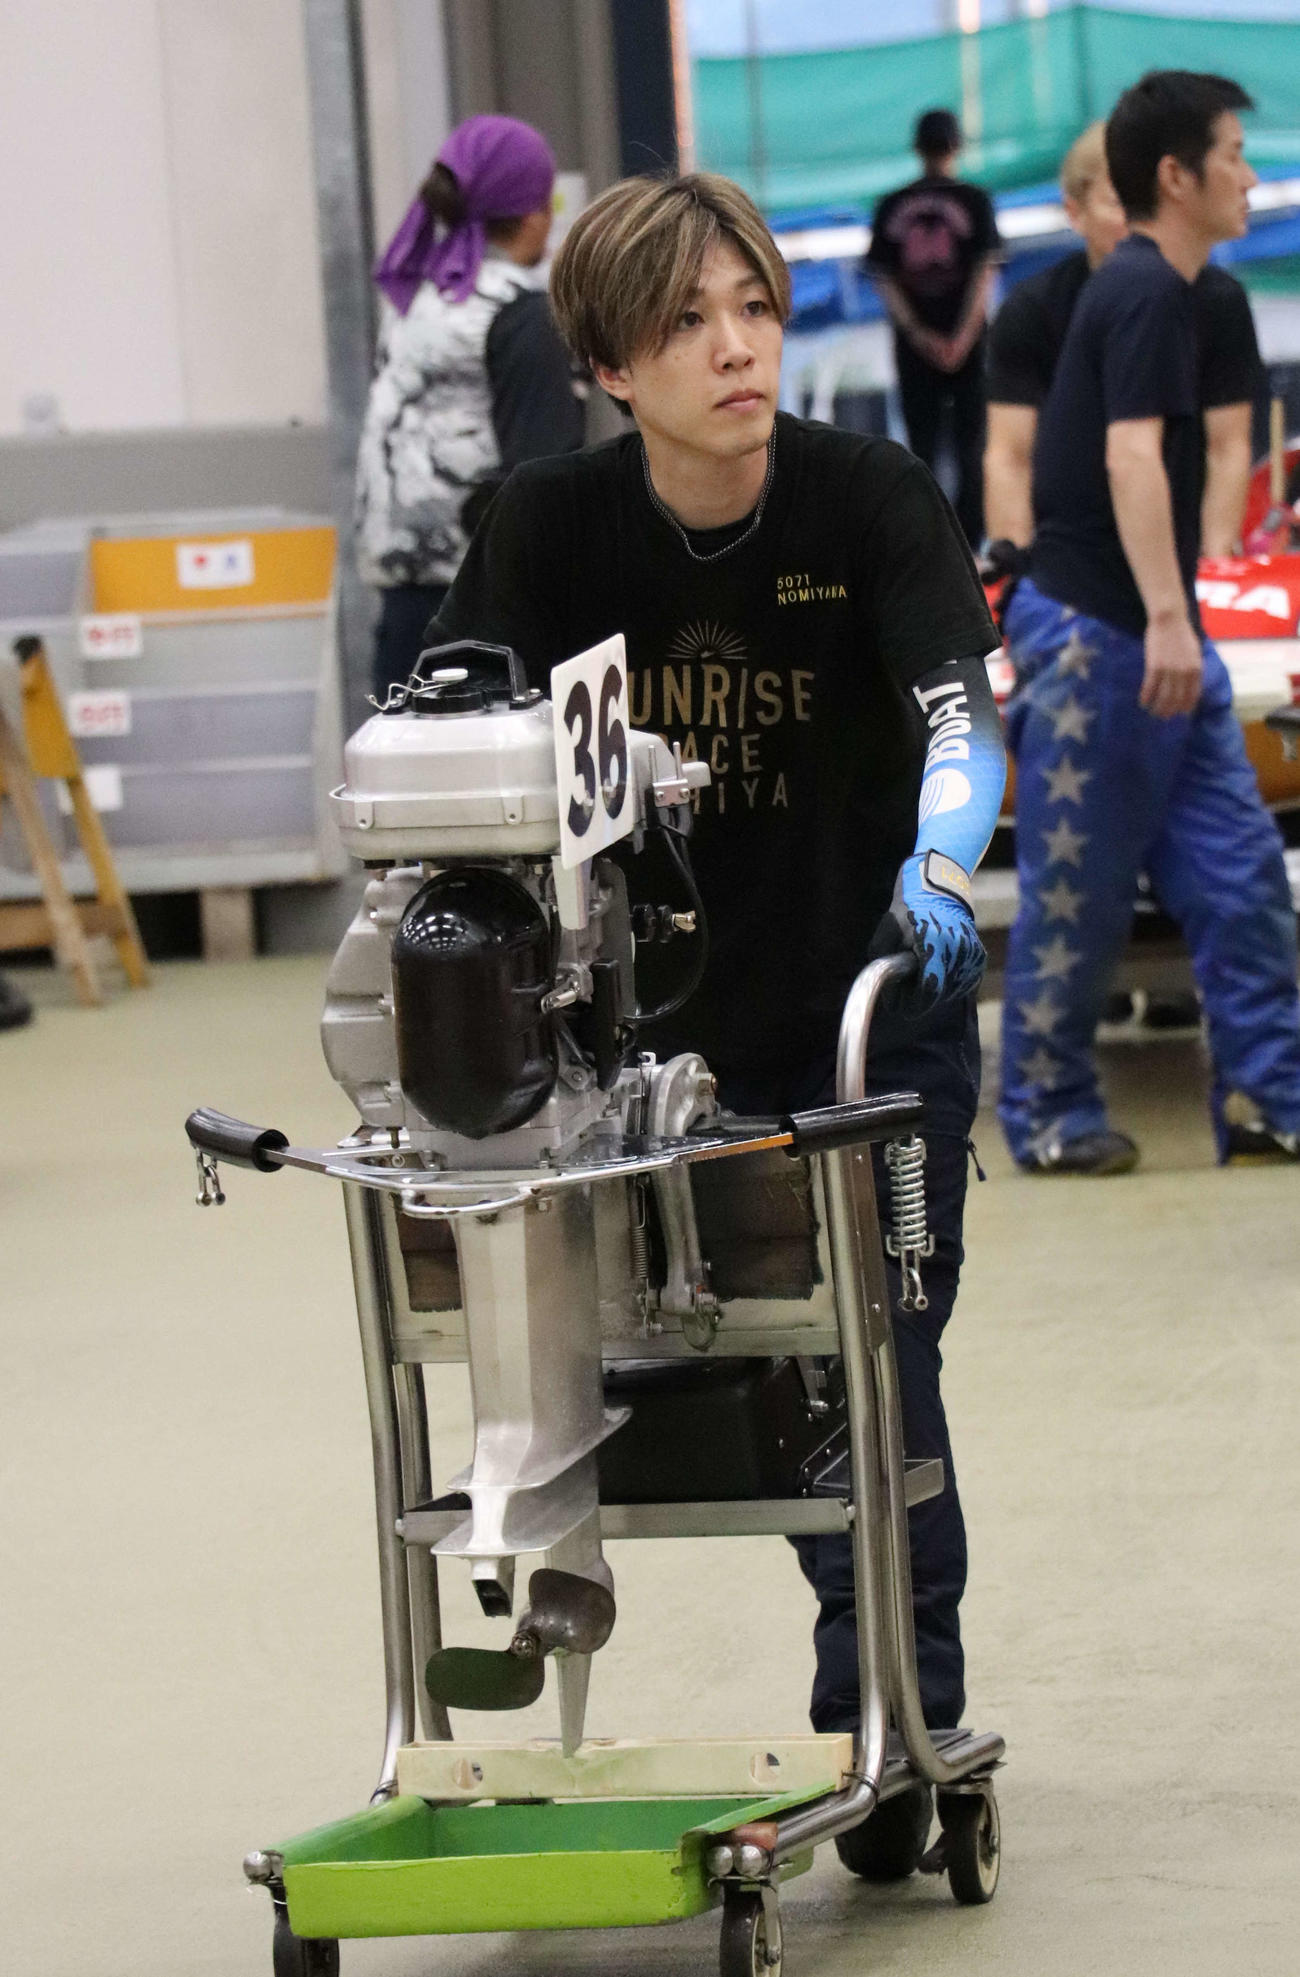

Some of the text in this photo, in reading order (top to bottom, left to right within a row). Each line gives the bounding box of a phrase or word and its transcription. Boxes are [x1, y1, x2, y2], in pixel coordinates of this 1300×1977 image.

[777, 574, 810, 590] 5071
[627, 664, 815, 729] UNRISE
[912, 682, 972, 776] BOAT
[564, 664, 628, 838] 36
[656, 731, 763, 774] ACE
